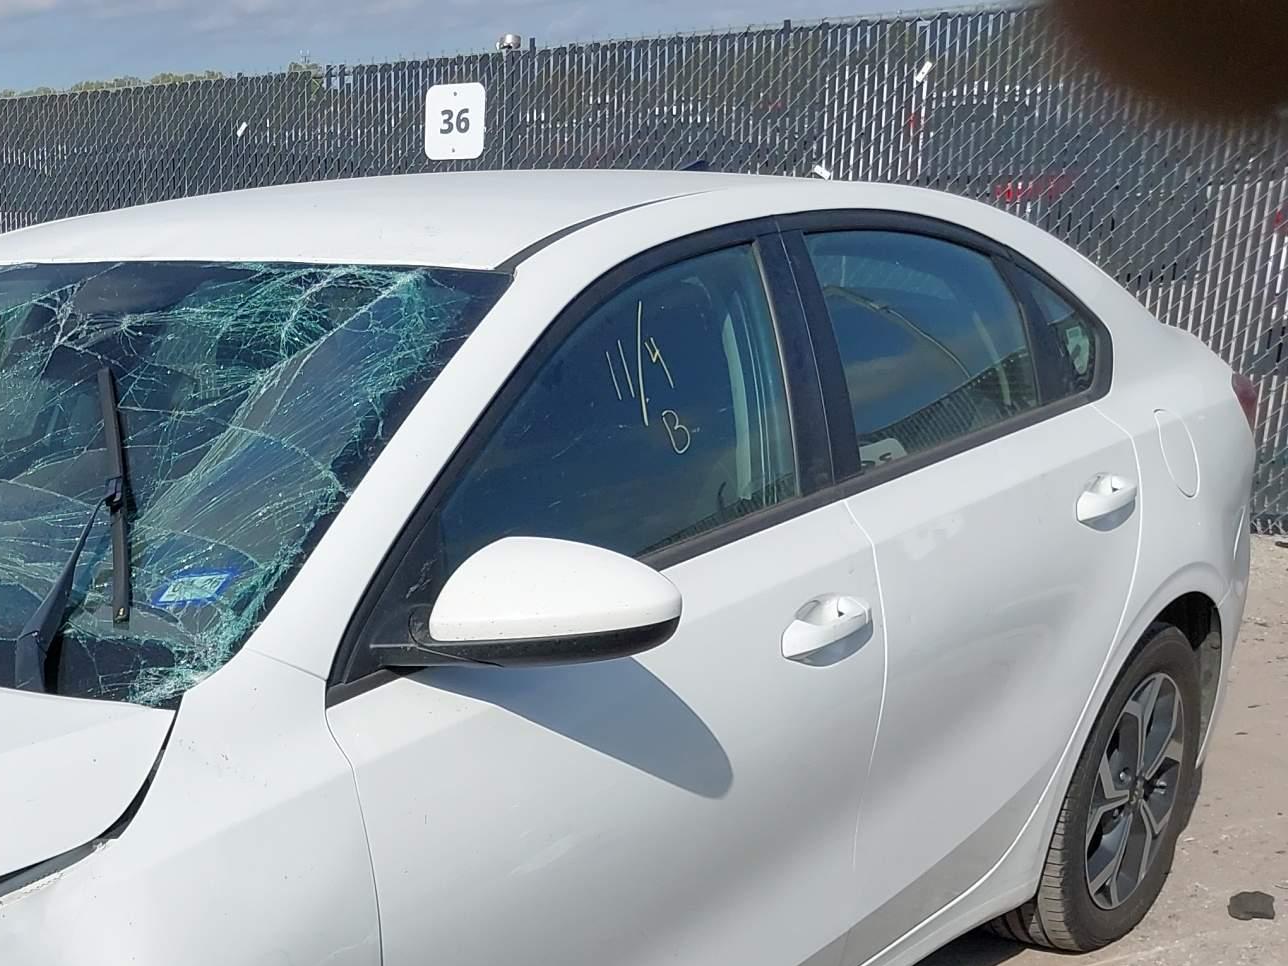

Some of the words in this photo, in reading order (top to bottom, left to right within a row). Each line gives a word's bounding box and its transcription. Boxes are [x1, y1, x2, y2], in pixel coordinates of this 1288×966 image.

[439, 107, 470, 135] 36
[605, 299, 676, 428] 11/4
[661, 409, 692, 455] B
